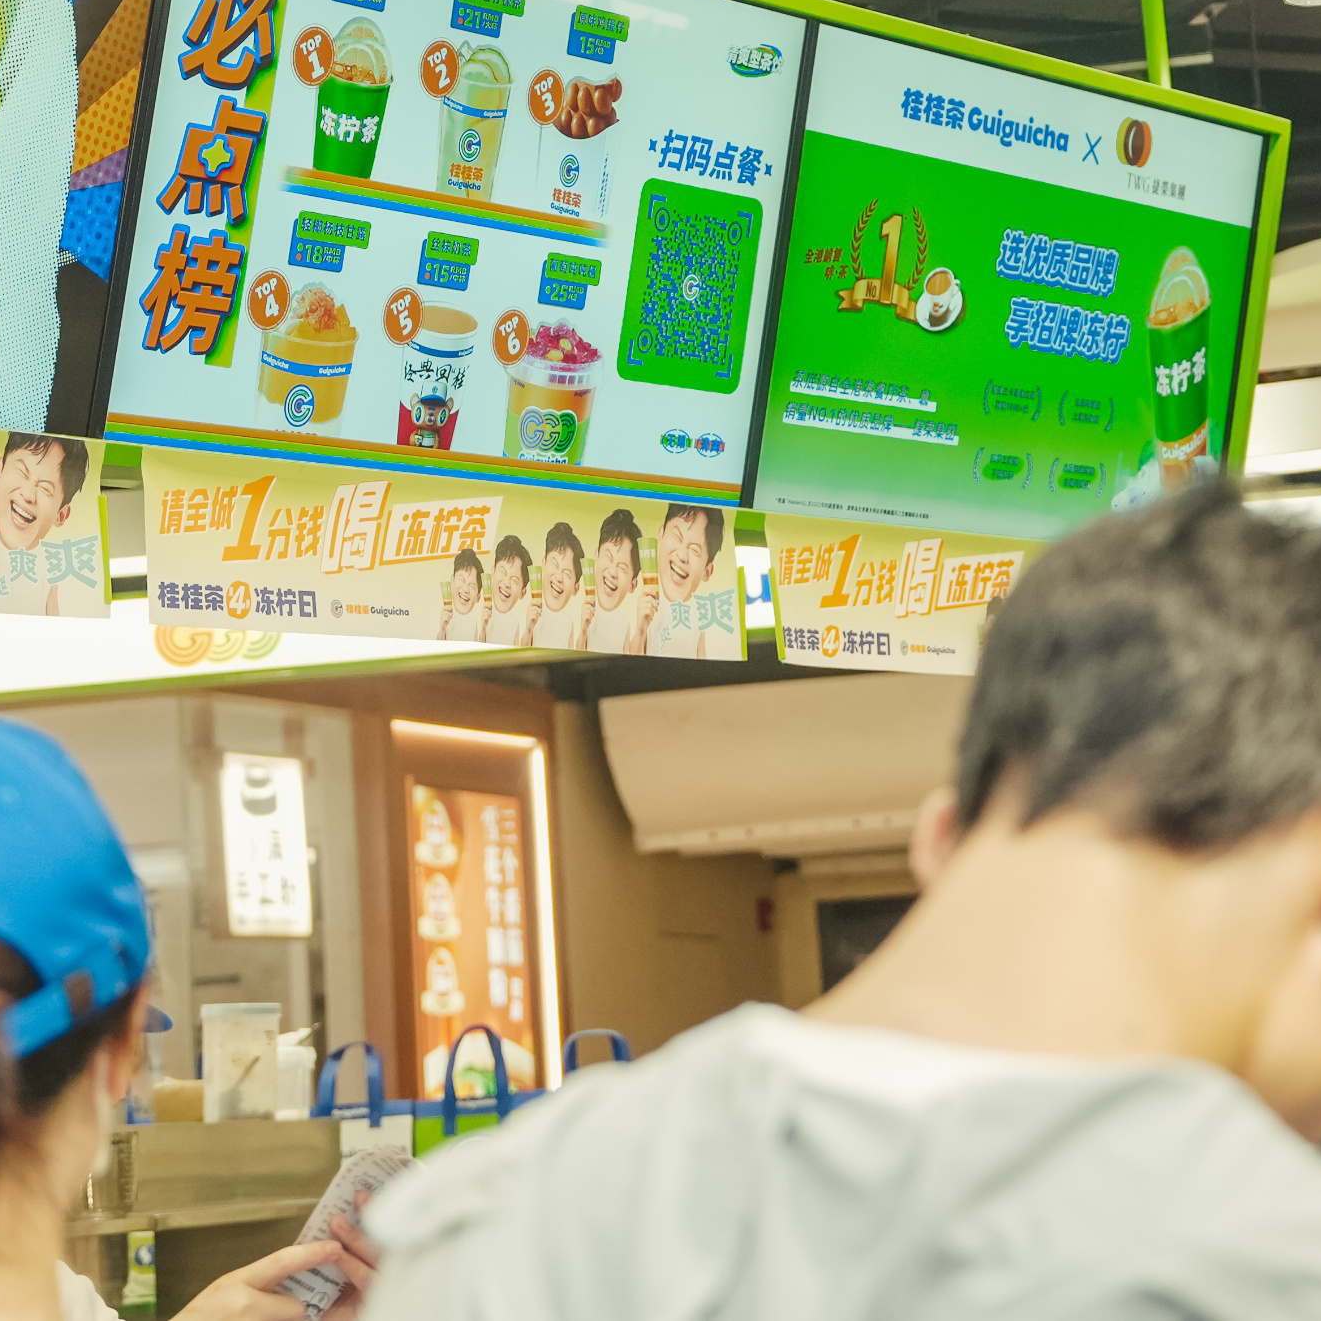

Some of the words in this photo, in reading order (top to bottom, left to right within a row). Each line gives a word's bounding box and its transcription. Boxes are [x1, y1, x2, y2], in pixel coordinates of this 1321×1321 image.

[464, 9, 482, 29] 21
[300, 34, 323, 55] TOP
[579, 36, 596, 56] 15
[308, 50, 325, 79] 1
[427, 47, 448, 68] TOP
[435, 64, 451, 90] 2
[534, 76, 554, 96] TOP
[541, 92, 555, 116] 3
[319, 105, 380, 143] 冻柠茶
[901, 87, 966, 130] 桂桂茶
[967, 106, 1070, 152] Guiguicha
[658, 129, 763, 186] 扫码点餐
[449, 163, 484, 182] 桂桂茶
[447, 178, 481, 191] Guiguicha
[552, 187, 582, 208] 桂桂茶
[305, 244, 324, 264] 18
[324, 246, 341, 256] RMB
[996, 228, 1120, 298] 选优质品牌
[433, 264, 450, 283] 15
[450, 265, 467, 275] RMB
[255, 277, 278, 300] TOP
[551, 283, 568, 302] 25
[264, 294, 280, 318] 4
[390, 294, 412, 316] TOP
[399, 310, 413, 335] 5
[498, 316, 519, 336] TOP
[1005, 296, 1132, 365] 享招牌冻柠
[507, 332, 521, 355] 6
[1155, 346, 1206, 397] 冻柠茶
[370, 606, 410, 618] Guiguicha
